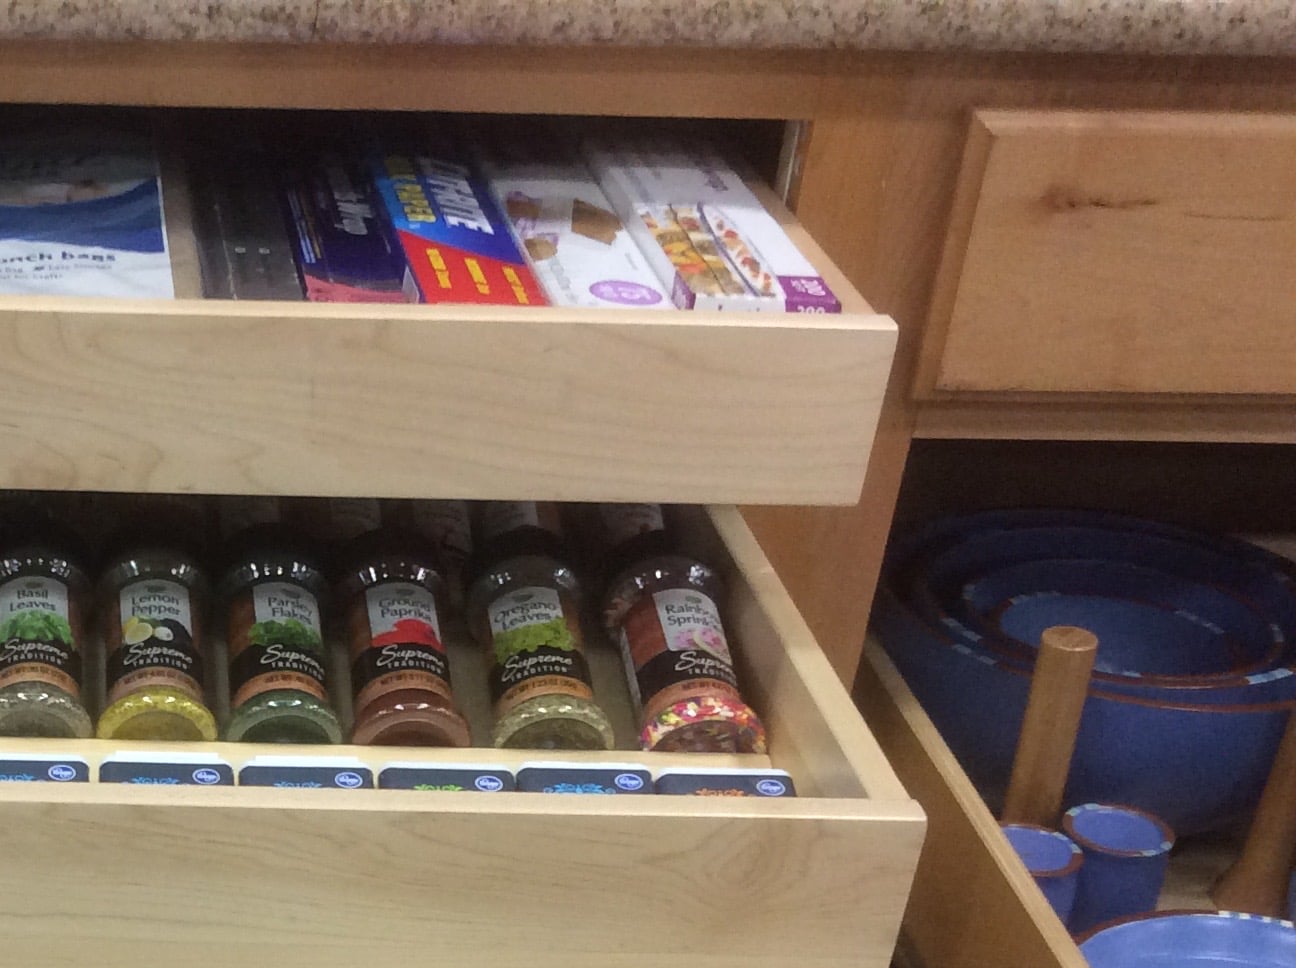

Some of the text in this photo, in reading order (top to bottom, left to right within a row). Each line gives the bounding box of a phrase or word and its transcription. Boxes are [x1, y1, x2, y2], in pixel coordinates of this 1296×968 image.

[16, 588, 49, 599] Basil
[131, 593, 180, 606] Lemon
[9, 600, 57, 612] Leaves
[131, 603, 181, 617] Pepper
[378, 598, 432, 612] Ground
[380, 607, 433, 623] Paprika
[502, 613, 552, 630] Leaves
[7, 651, 63, 666] TRADITION
[123, 642, 193, 666] Supreme
[260, 644, 325, 675] Supreme
[376, 645, 445, 669] Supreme
[133, 655, 188, 670] TRADITION
[387, 660, 443, 675] TRADITION
[501, 654, 573, 682] Supreme
[271, 661, 324, 681] TRADITION
[510, 665, 568, 682] TRADITION
